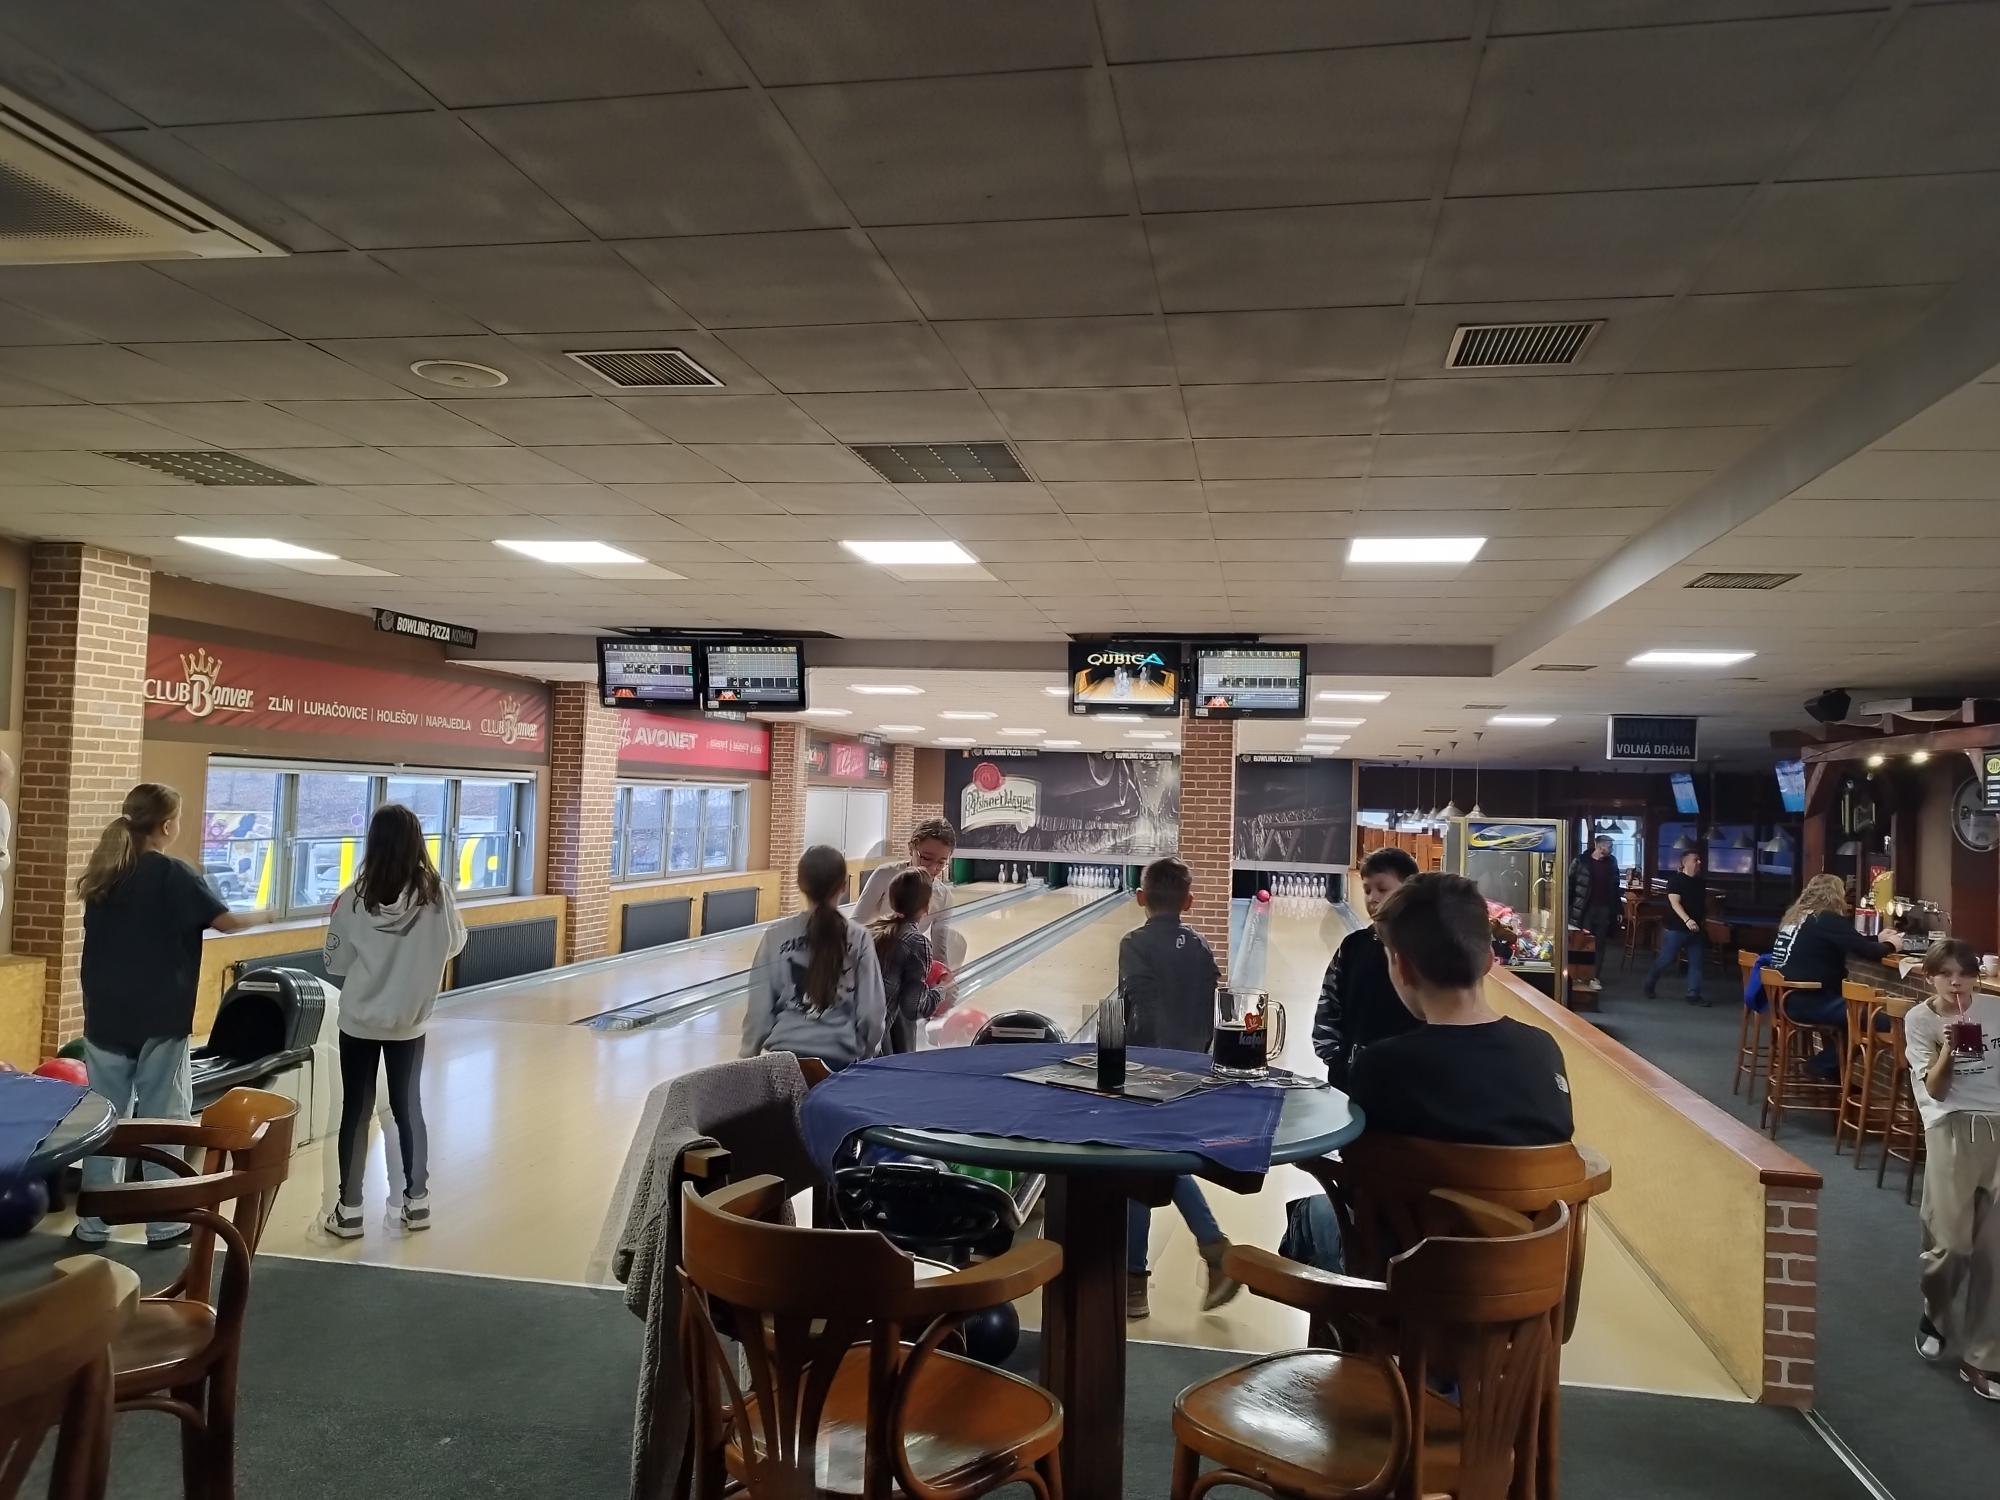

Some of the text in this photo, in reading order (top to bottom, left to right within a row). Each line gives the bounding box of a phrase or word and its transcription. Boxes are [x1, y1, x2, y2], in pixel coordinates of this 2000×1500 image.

[396, 616, 430, 637] BOWLING
[429, 623, 451, 641] PIZZA
[1087, 651, 1165, 670] QUBICA
[143, 674, 254, 717] CLUB Bonver
[267, 695, 471, 731] ZLÍN LUHAČOVICE HOLEŠOV NAPAJEDLA
[480, 718, 505, 735] CLUB
[634, 726, 698, 750] AVONET
[1616, 741, 1690, 755] VOLNÁ DRÁHA
[1253, 754, 1277, 762] BOWLING
[1278, 755, 1293, 763] PIZZA
